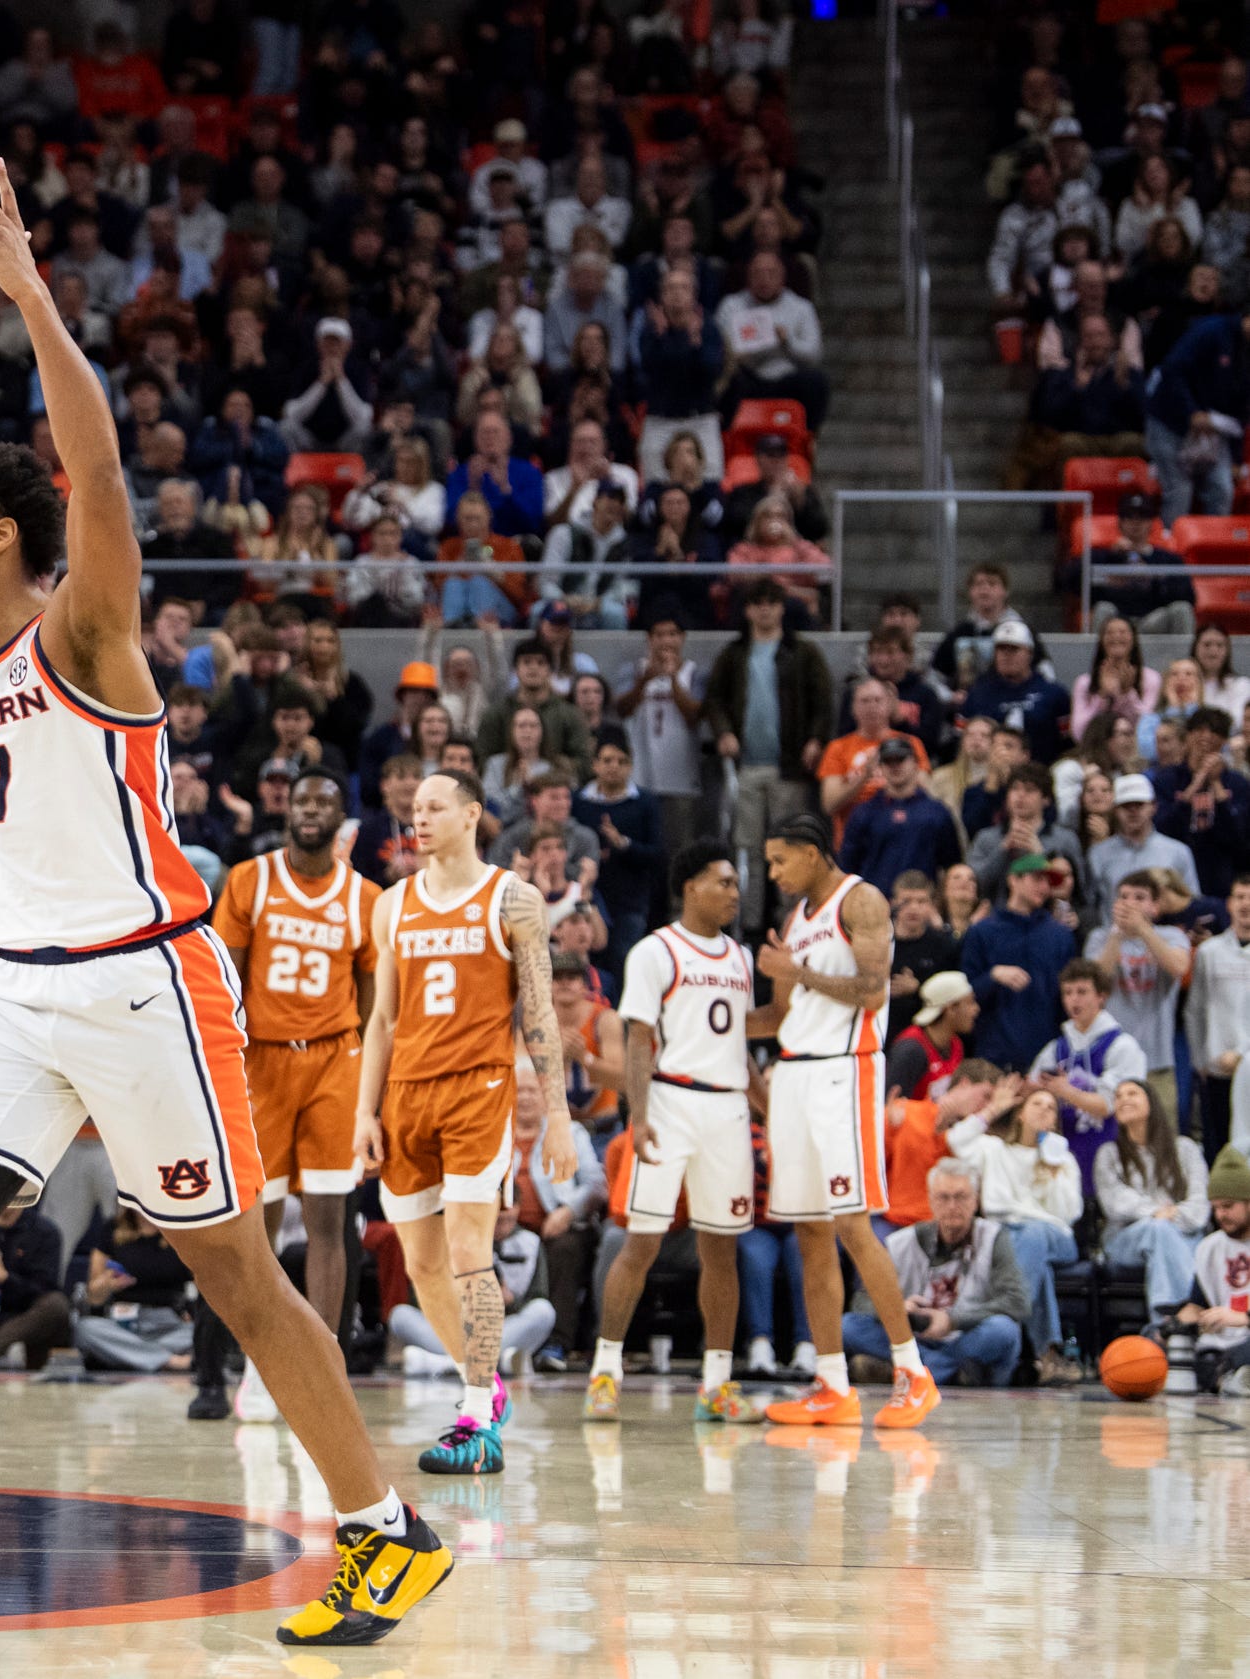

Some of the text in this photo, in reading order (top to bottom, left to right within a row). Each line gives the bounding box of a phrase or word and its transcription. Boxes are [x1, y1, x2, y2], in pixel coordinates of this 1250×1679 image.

[266, 913, 346, 950] TEXAS
[398, 926, 486, 958] TEXAS
[267, 944, 330, 997] 23
[424, 960, 456, 1016] 2
[681, 974, 749, 993] AUBURN
[708, 998, 732, 1034] 0
